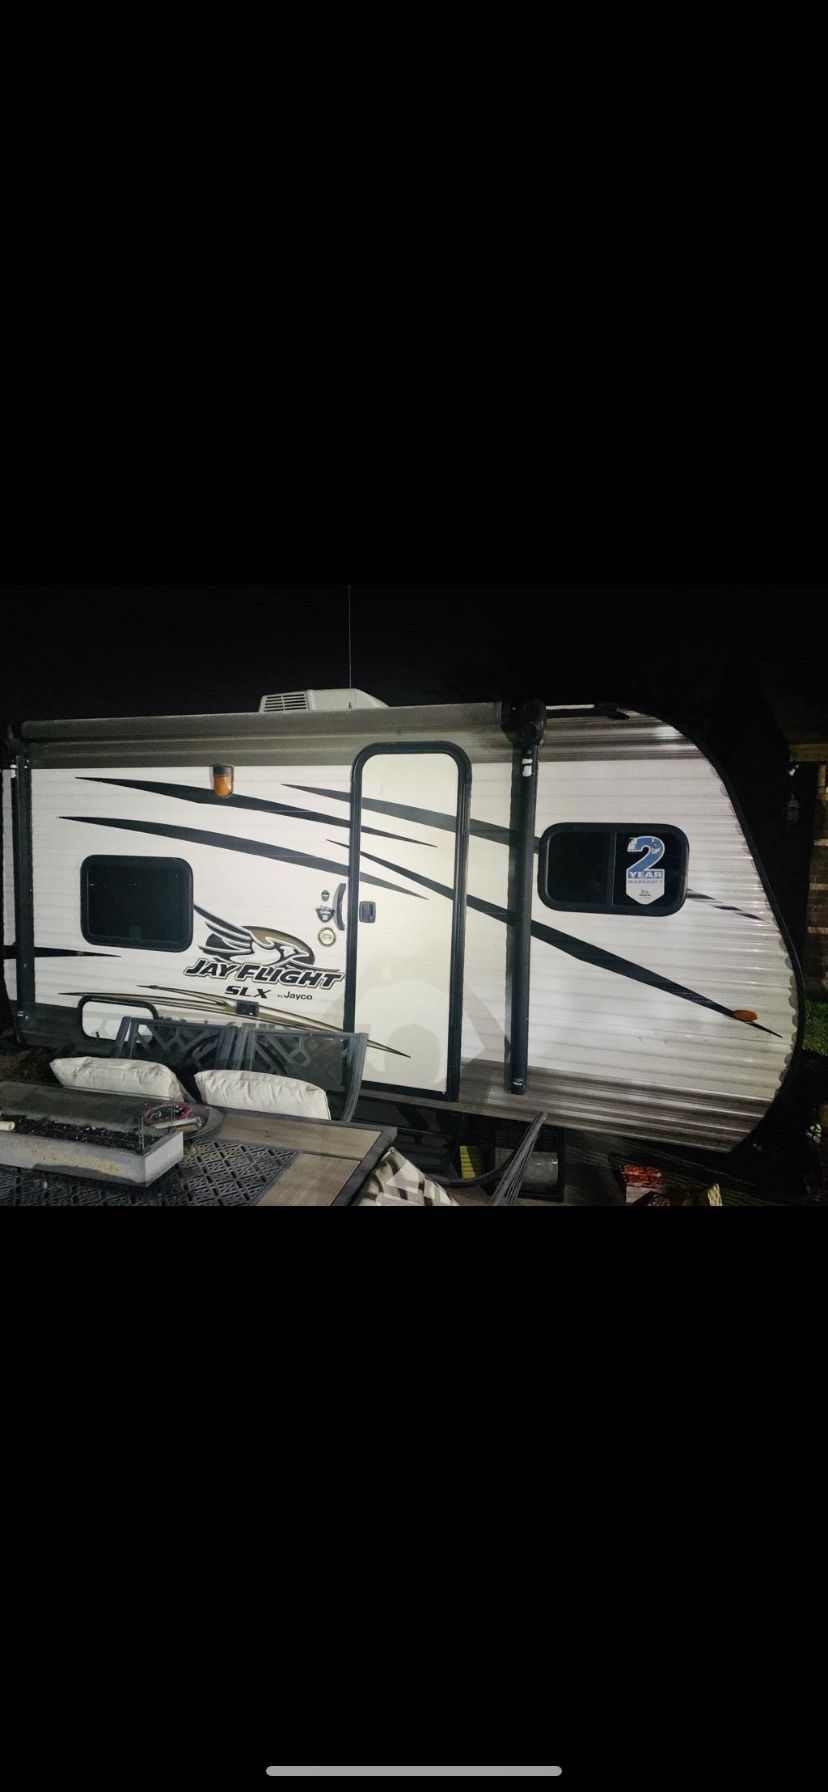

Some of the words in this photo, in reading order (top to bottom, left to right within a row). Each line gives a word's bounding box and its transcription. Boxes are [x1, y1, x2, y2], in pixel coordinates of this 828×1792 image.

[627, 836, 664, 871] 2
[184, 959, 236, 978] JAY
[235, 963, 345, 989] FLIGHT
[225, 985, 271, 999] SLX
[284, 991, 313, 1000] Jayco
